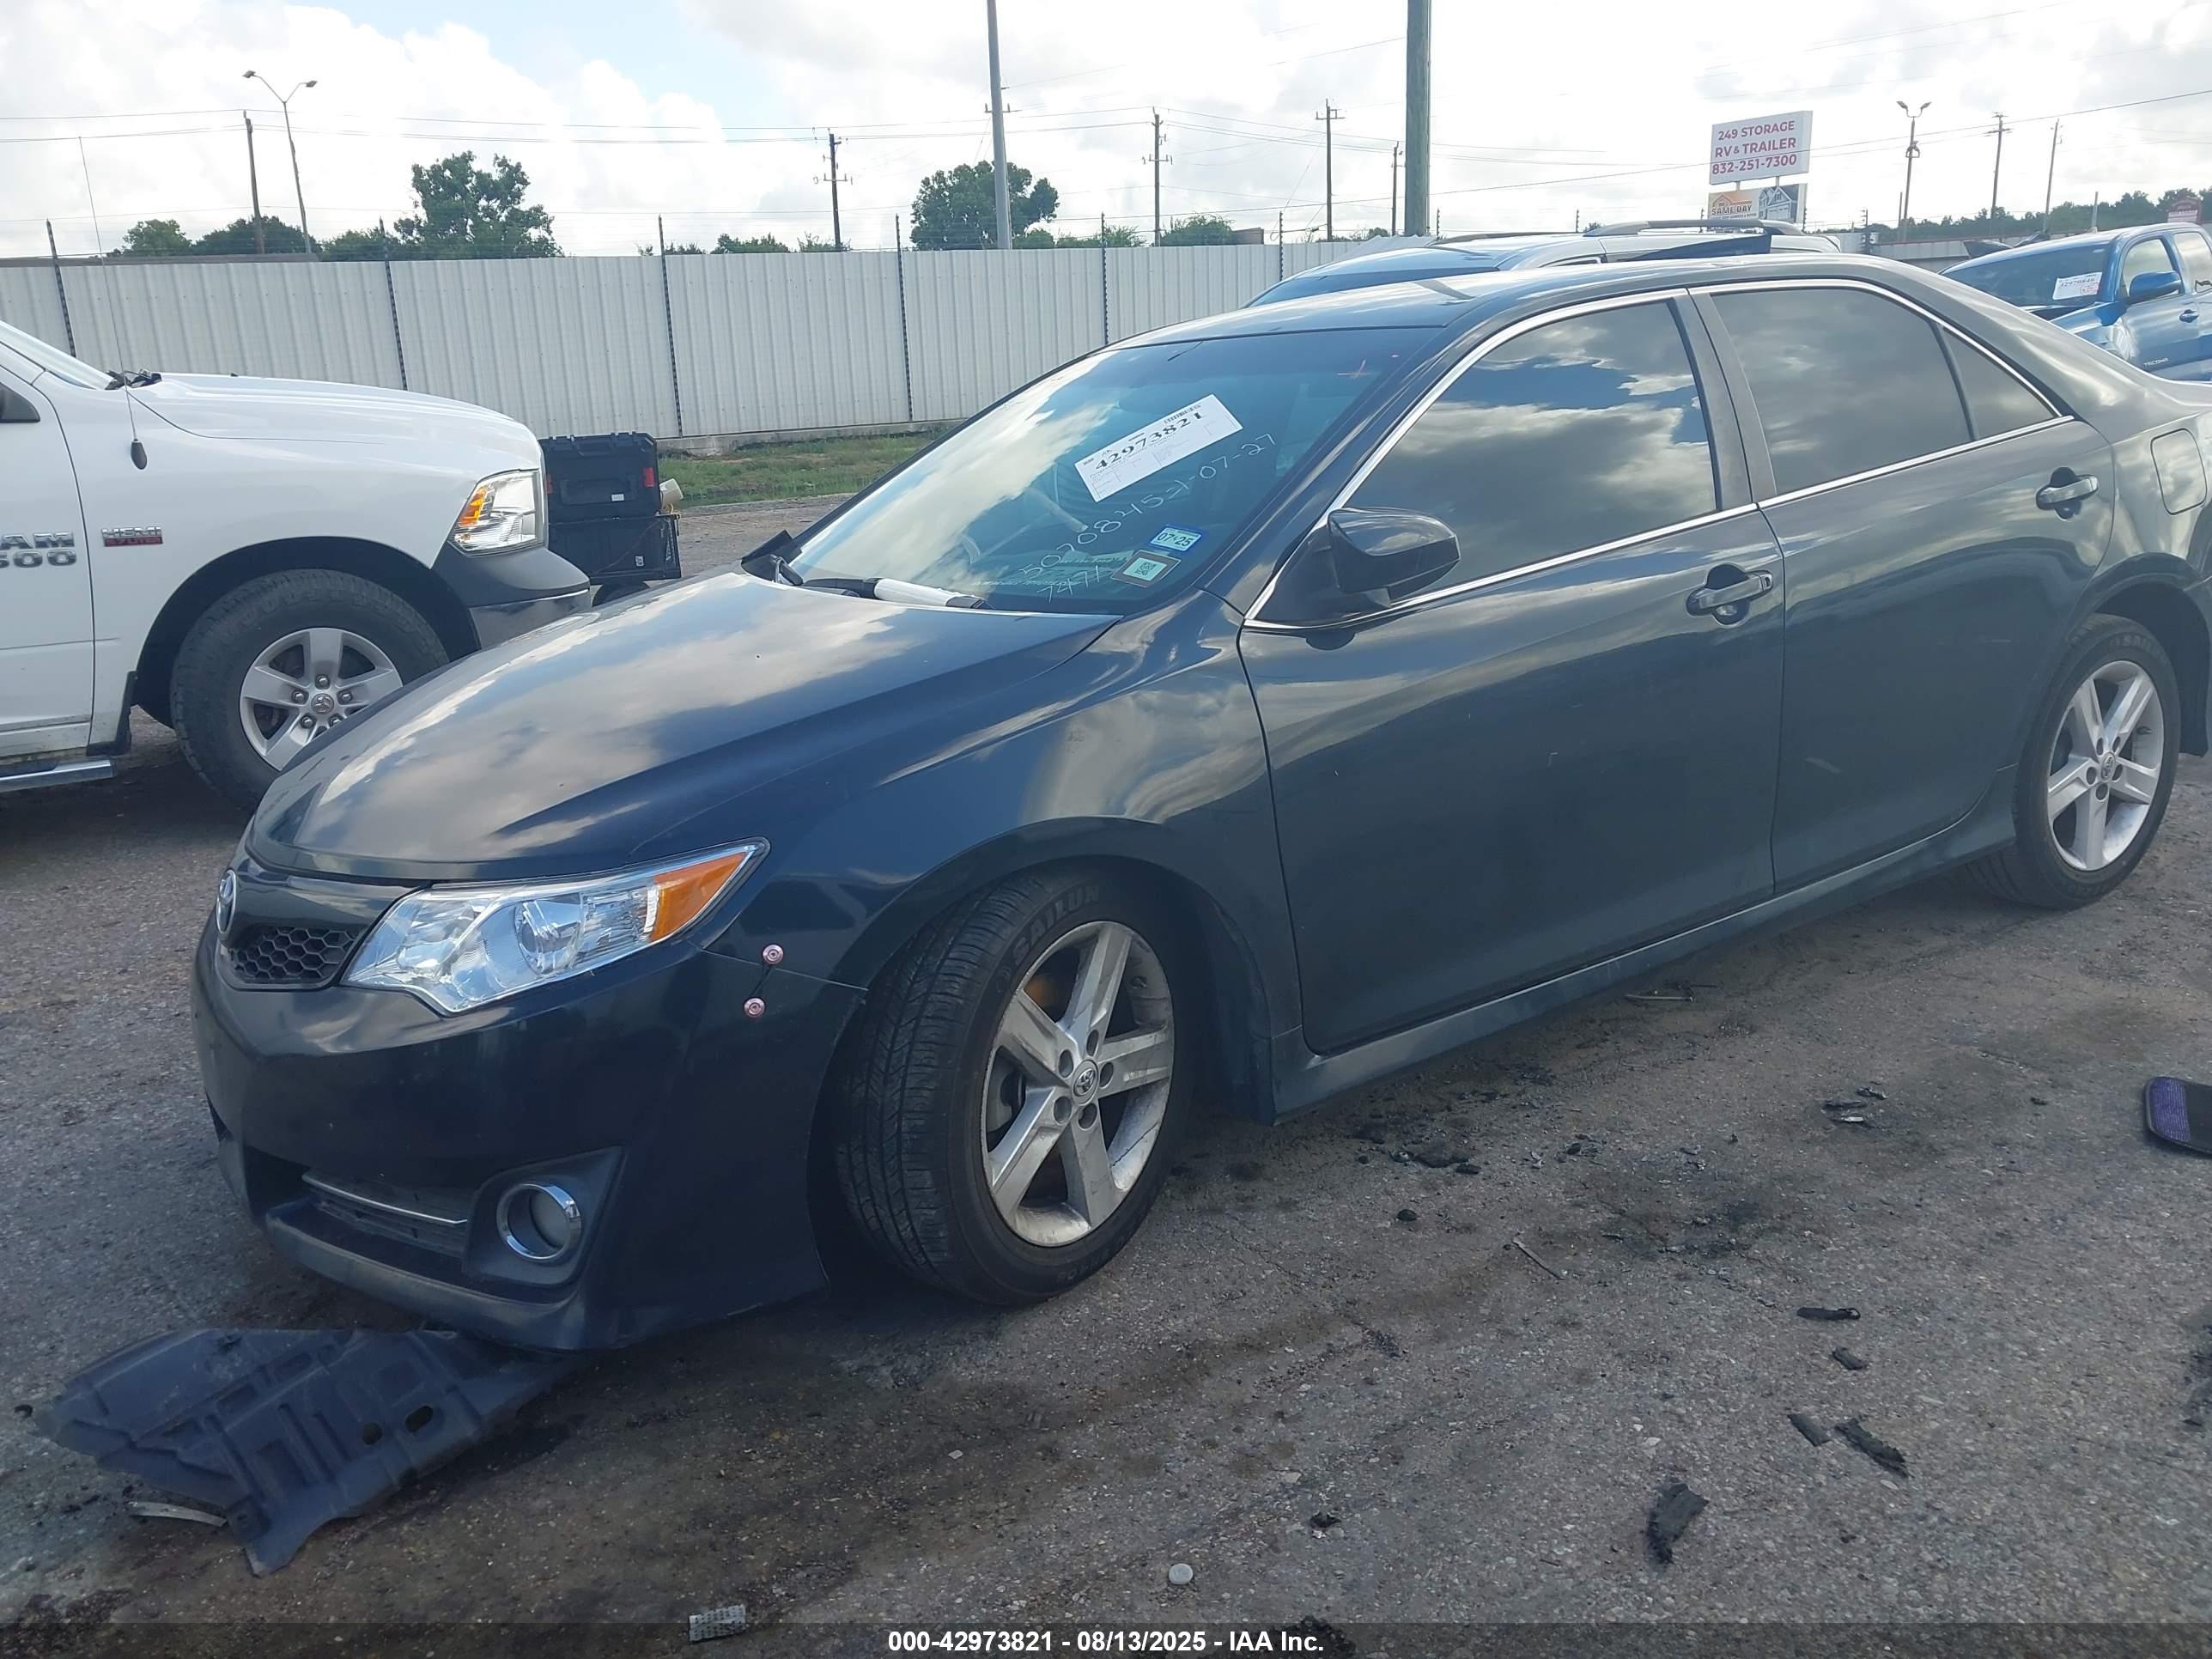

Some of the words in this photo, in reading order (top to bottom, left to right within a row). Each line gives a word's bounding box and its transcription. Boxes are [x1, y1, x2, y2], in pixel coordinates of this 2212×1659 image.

[1717, 129, 1738, 141] 249
[1741, 120, 1796, 137] STORAGE
[1742, 137, 1796, 155] TRAILER
[1712, 154, 1797, 175] 832-251-7300
[1095, 411, 1203, 471] 42973821
[1157, 532, 1174, 542] 07
[1174, 536, 1194, 547] 25
